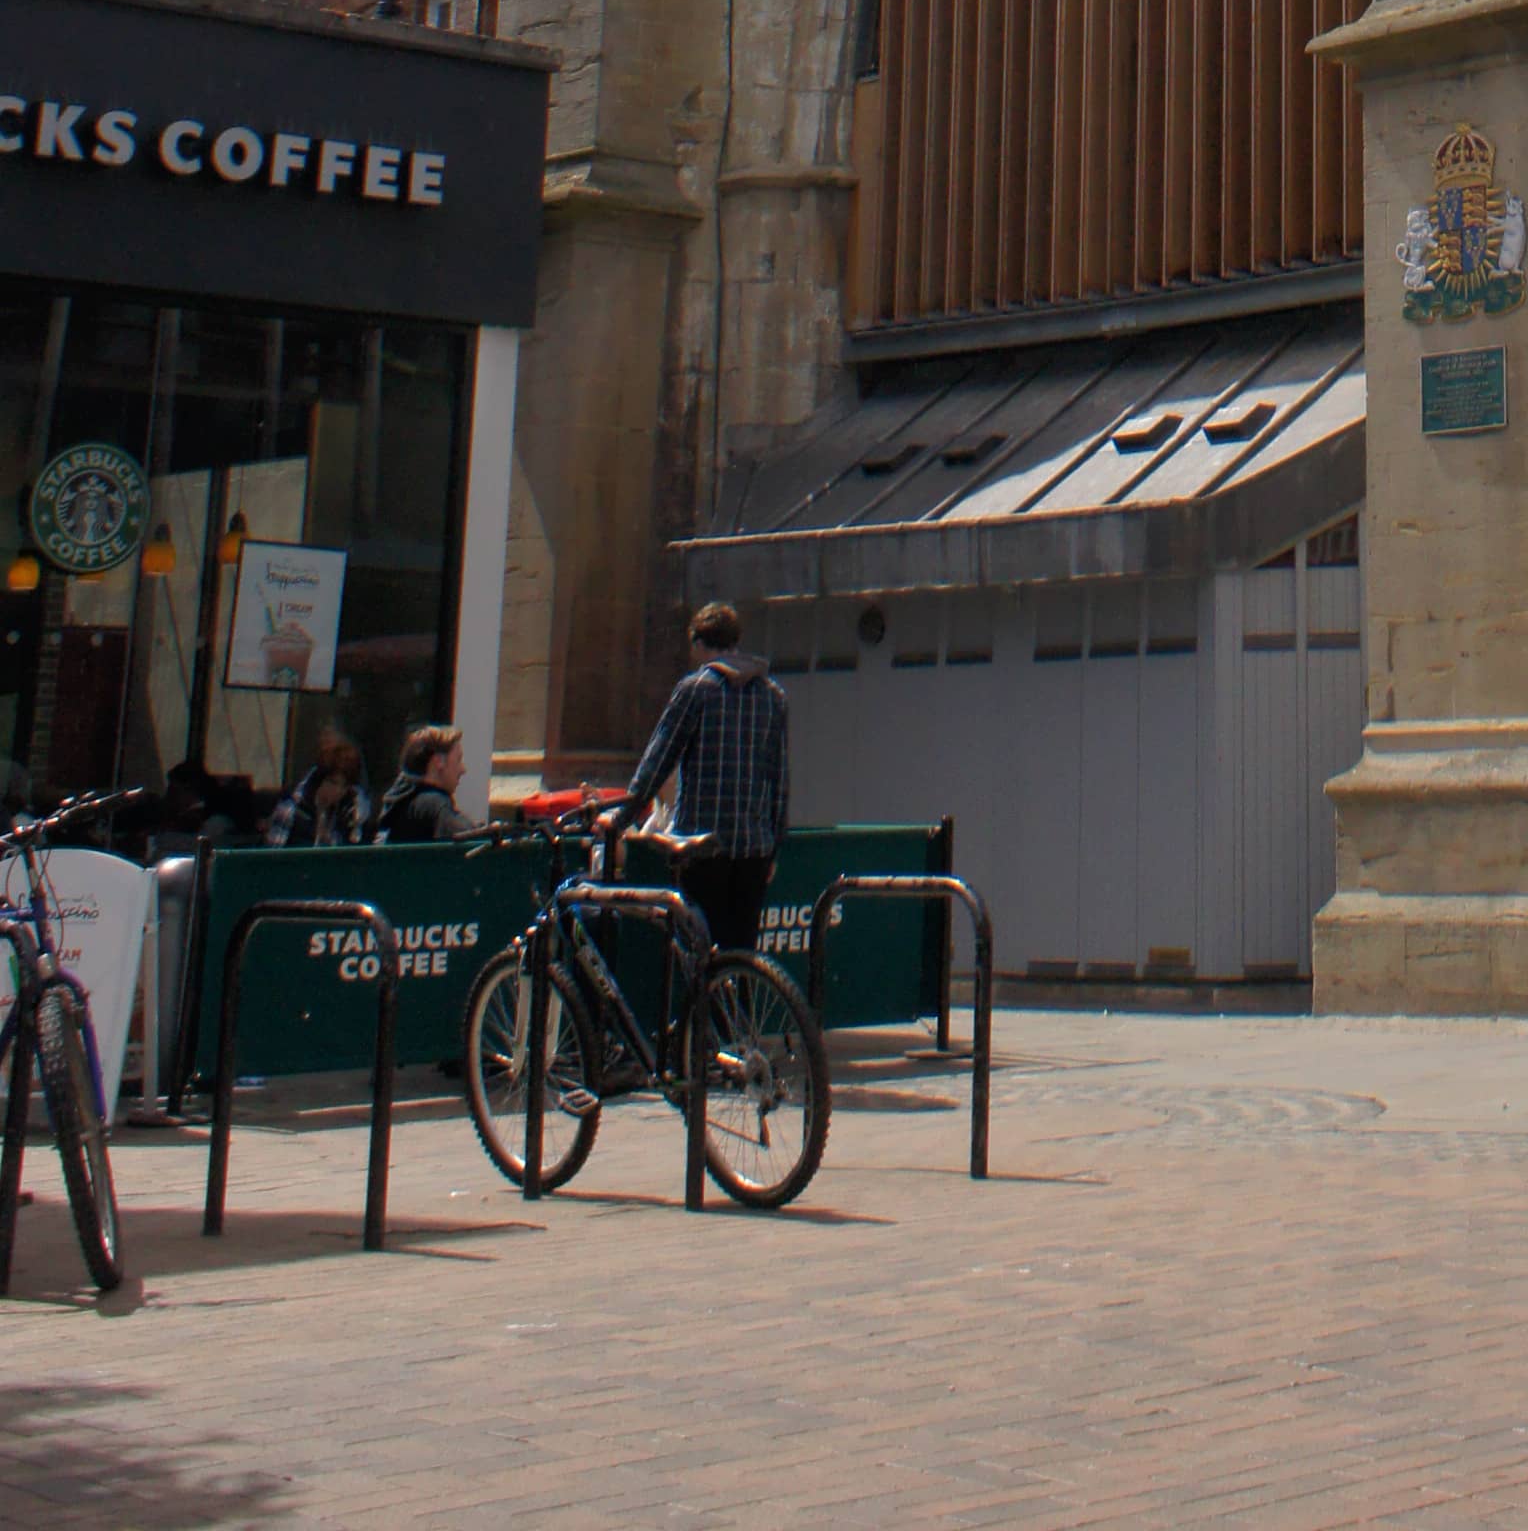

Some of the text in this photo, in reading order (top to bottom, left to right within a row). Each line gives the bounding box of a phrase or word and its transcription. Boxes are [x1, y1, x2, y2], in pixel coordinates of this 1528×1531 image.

[160, 119, 446, 206] COFFEE
[39, 450, 142, 502] STARBUCKS
[48, 532, 127, 565] COFFEE
[338, 951, 449, 981] COFEE
